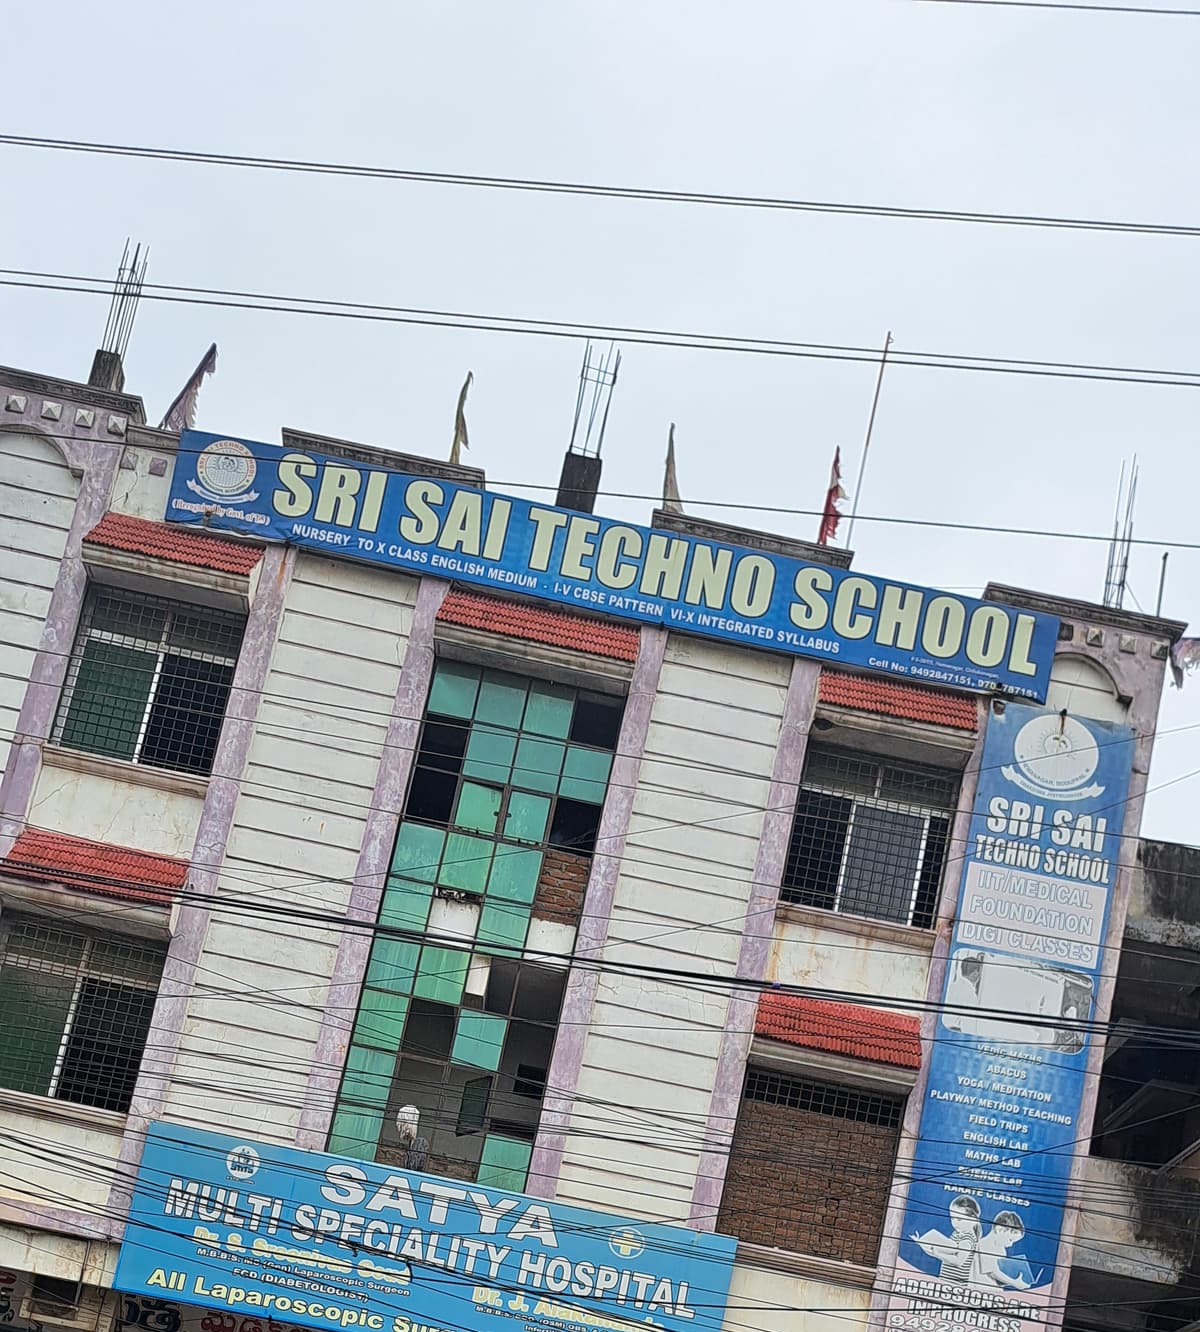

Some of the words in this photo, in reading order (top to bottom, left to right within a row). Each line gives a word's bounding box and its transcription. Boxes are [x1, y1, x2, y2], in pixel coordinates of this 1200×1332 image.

[272, 454, 388, 534] SRI
[400, 480, 511, 561] SAI
[529, 507, 776, 619] TECHNO
[789, 567, 1036, 677] SCHOOL
[292, 524, 350, 546] NURSERY
[358, 538, 374, 552] TO
[376, 541, 386, 553] X
[388, 544, 428, 566] CLASS
[431, 554, 485, 577] ENGLISH
[487, 567, 537, 589] MEDIUM
[553, 583, 571, 598] I-V
[574, 586, 605, 605] CBSE
[608, 594, 663, 617] PATTERN
[671, 607, 695, 623] VI-X
[697, 613, 774, 640] INTEGRATED
[777, 629, 839, 654] SYLLABUS
[869, 657, 888, 668] Cell
[890, 662, 908, 673] No:
[978, 679, 1038, 698] 970787151
[986, 797, 1044, 840] SRI
[1051, 810, 1107, 852] SAI
[975, 835, 1041, 870] TECHNO
[1044, 849, 1109, 884] SCHOOL
[977, 870, 1093, 909] IIT/MEDICAL
[970, 895, 1093, 936] FOUNDATION
[962, 924, 1002, 944] DIGI
[1007, 931, 1093, 962] CLASSES
[958, 1076, 984, 1090] YOGA
[991, 1083, 1051, 1103] MEDITATION
[986, 1065, 1027, 1079] ABACUS
[930, 1090, 976, 1106] PLAYWAY
[978, 1097, 1020, 1114] METHOD
[1022, 1106, 1072, 1125] TEACHING
[969, 1115, 997, 1128] FIELD
[999, 1120, 1028, 1134] TRIPS
[963, 1131, 1006, 1149] ENGLISH
[1008, 1140, 1028, 1152] LAB
[965, 1149, 999, 1164] MATHS
[1001, 1156, 1021, 1168] LAB
[320, 1164, 558, 1248] SATYA
[164, 1178, 283, 1236] MULTI
[291, 1203, 511, 1280] SPECIALITY
[517, 1250, 696, 1320] HOSPITAL
[196, 1247, 241, 1264] M.B.B.S.
[294, 1265, 364, 1288] Laparoscopic
[366, 1279, 410, 1297] Surgeon
[260, 1271, 370, 1304] (DIABETOLOGIST)
[147, 1268, 186, 1292] All
[193, 1276, 383, 1328] Laparoscopic
[472, 1285, 503, 1310] Dr.
[893, 1278, 1004, 1311] ADMISSIONS
[908, 1300, 926, 1315] IN
